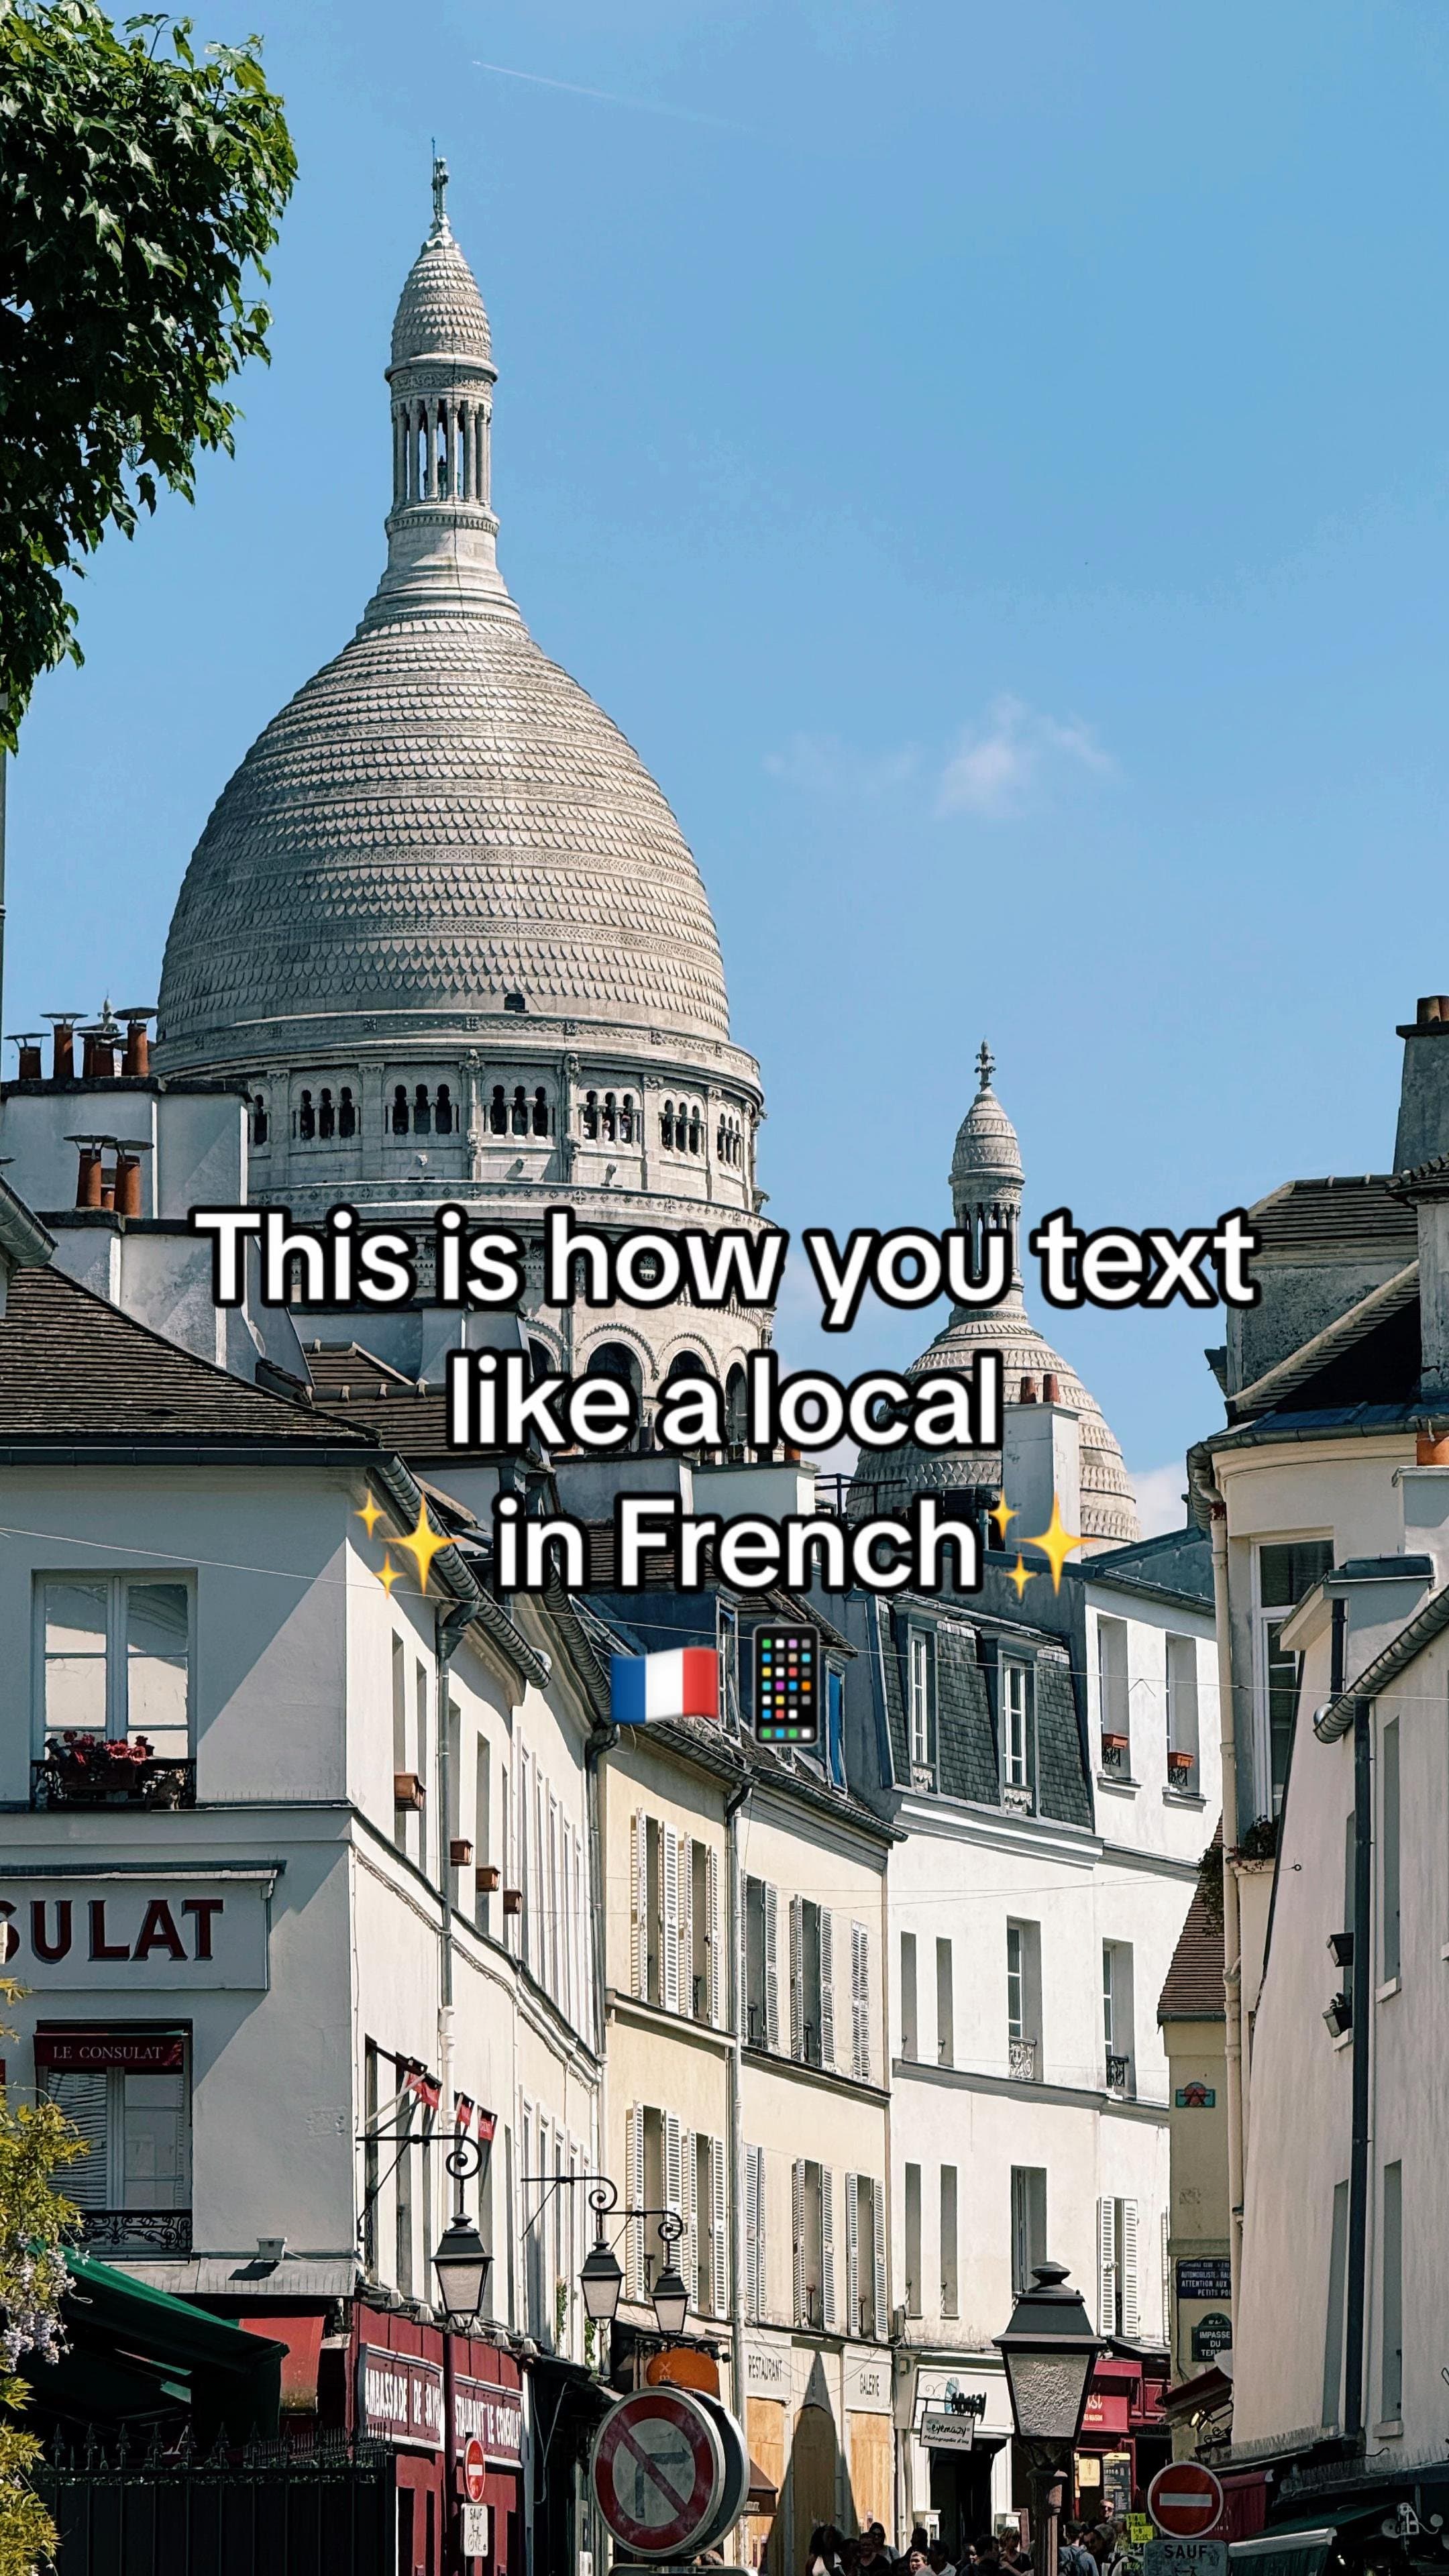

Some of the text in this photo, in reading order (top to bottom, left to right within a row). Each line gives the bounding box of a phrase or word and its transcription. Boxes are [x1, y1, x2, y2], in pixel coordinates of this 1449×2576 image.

[54, 2046, 163, 2059] LE CONSULAT
[1197, 2288, 1218, 2296] PETITS
[1199, 2330, 1231, 2339] IMPASSE
[1210, 2339, 1221, 2347] DU
[748, 2355, 783, 2381] RESTAURANT
[859, 2373, 879, 2397] GALERIE
[365, 2367, 408, 2423] AMBASSADE
[413, 2379, 422, 2425] DE
[470, 2508, 482, 2520] SAUF
[1165, 2544, 1208, 2559] SAUF
